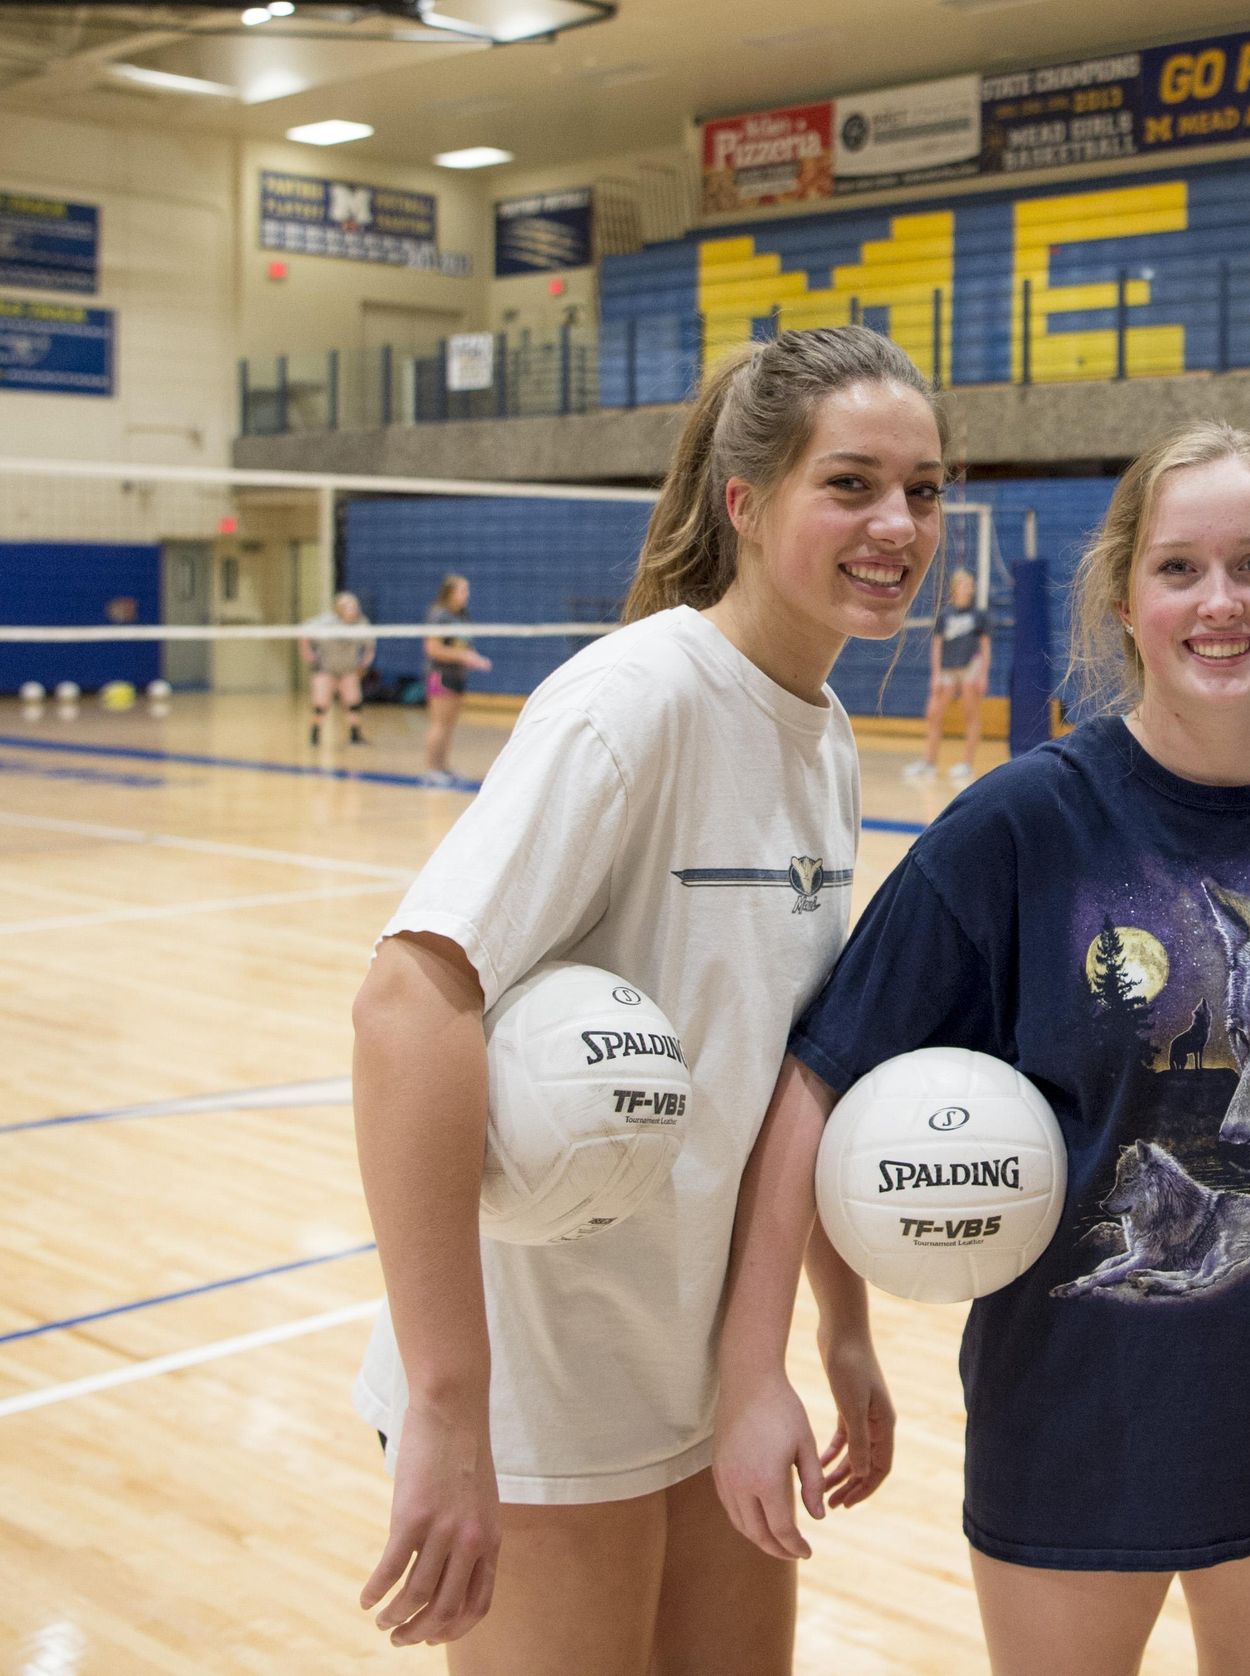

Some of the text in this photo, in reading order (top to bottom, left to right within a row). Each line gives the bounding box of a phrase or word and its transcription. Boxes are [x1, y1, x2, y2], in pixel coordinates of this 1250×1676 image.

[1160, 48, 1226, 104] GO
[1177, 106, 1240, 137] MEAD
[714, 129, 821, 171] Pizzeria
[581, 1031, 689, 1069] SPALDIN
[613, 1089, 687, 1116] TF-VB5
[879, 1156, 1019, 1193] SPALDING
[899, 1215, 1002, 1239] TF-VB5
[913, 1239, 957, 1247] Tournament
